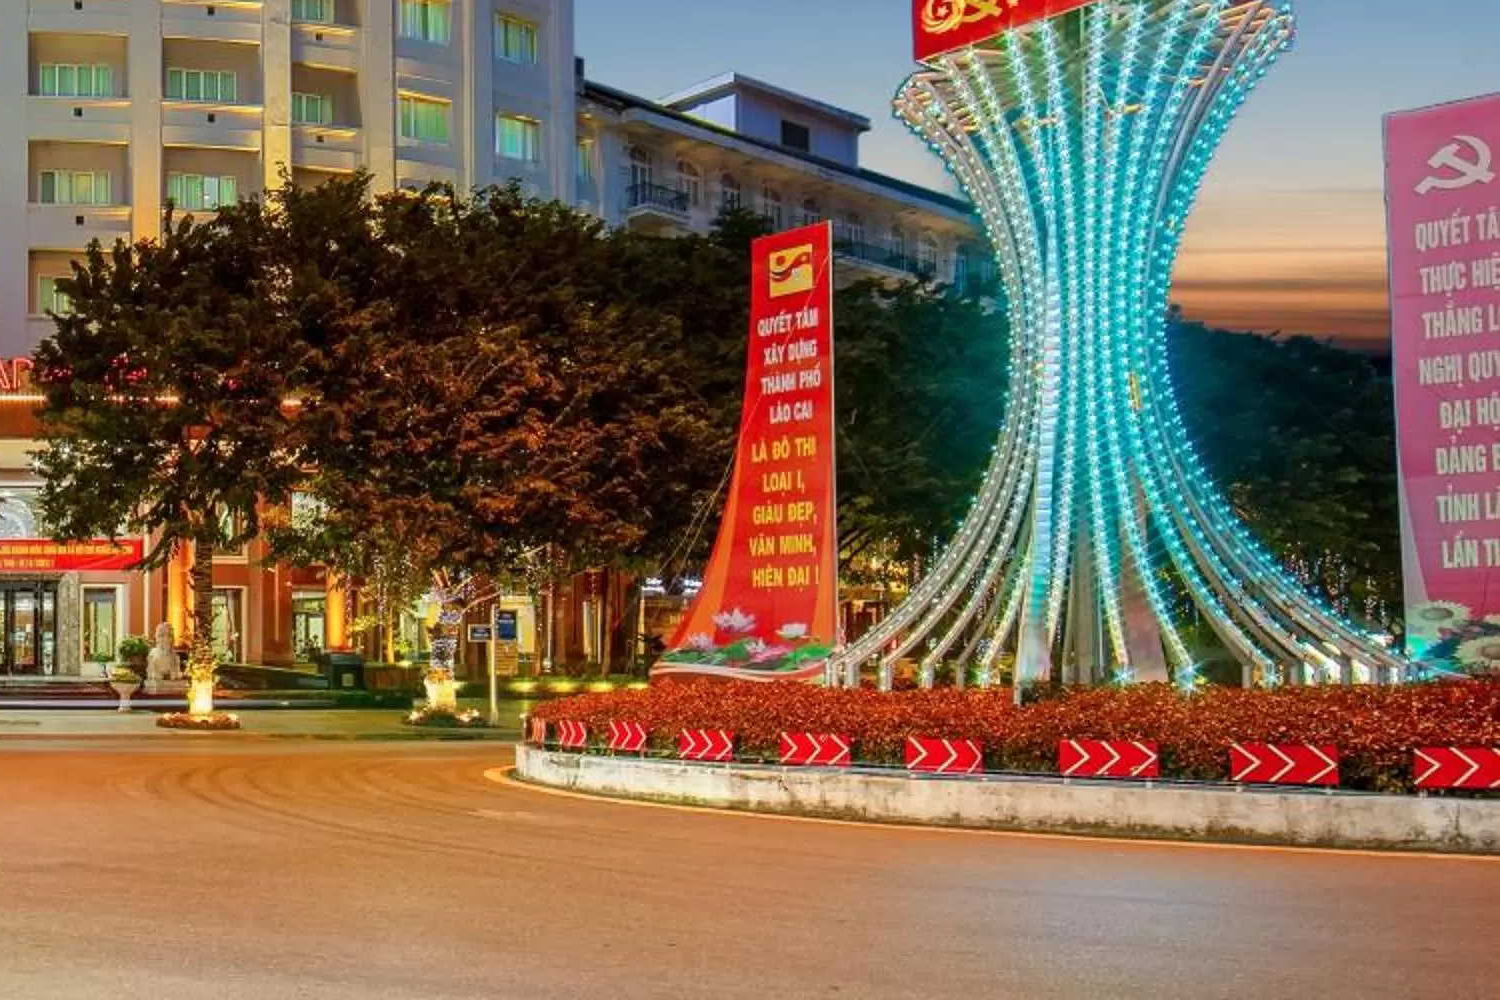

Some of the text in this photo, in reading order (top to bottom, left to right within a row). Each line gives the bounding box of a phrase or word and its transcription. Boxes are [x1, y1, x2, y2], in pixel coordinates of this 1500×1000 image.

[1415, 207, 1471, 252] QUYẾT
[1419, 260, 1467, 296] THỰC
[1488, 303, 1500, 332] L
[1418, 353, 1464, 388] NGHỊ
[793, 401, 813, 420] CAI
